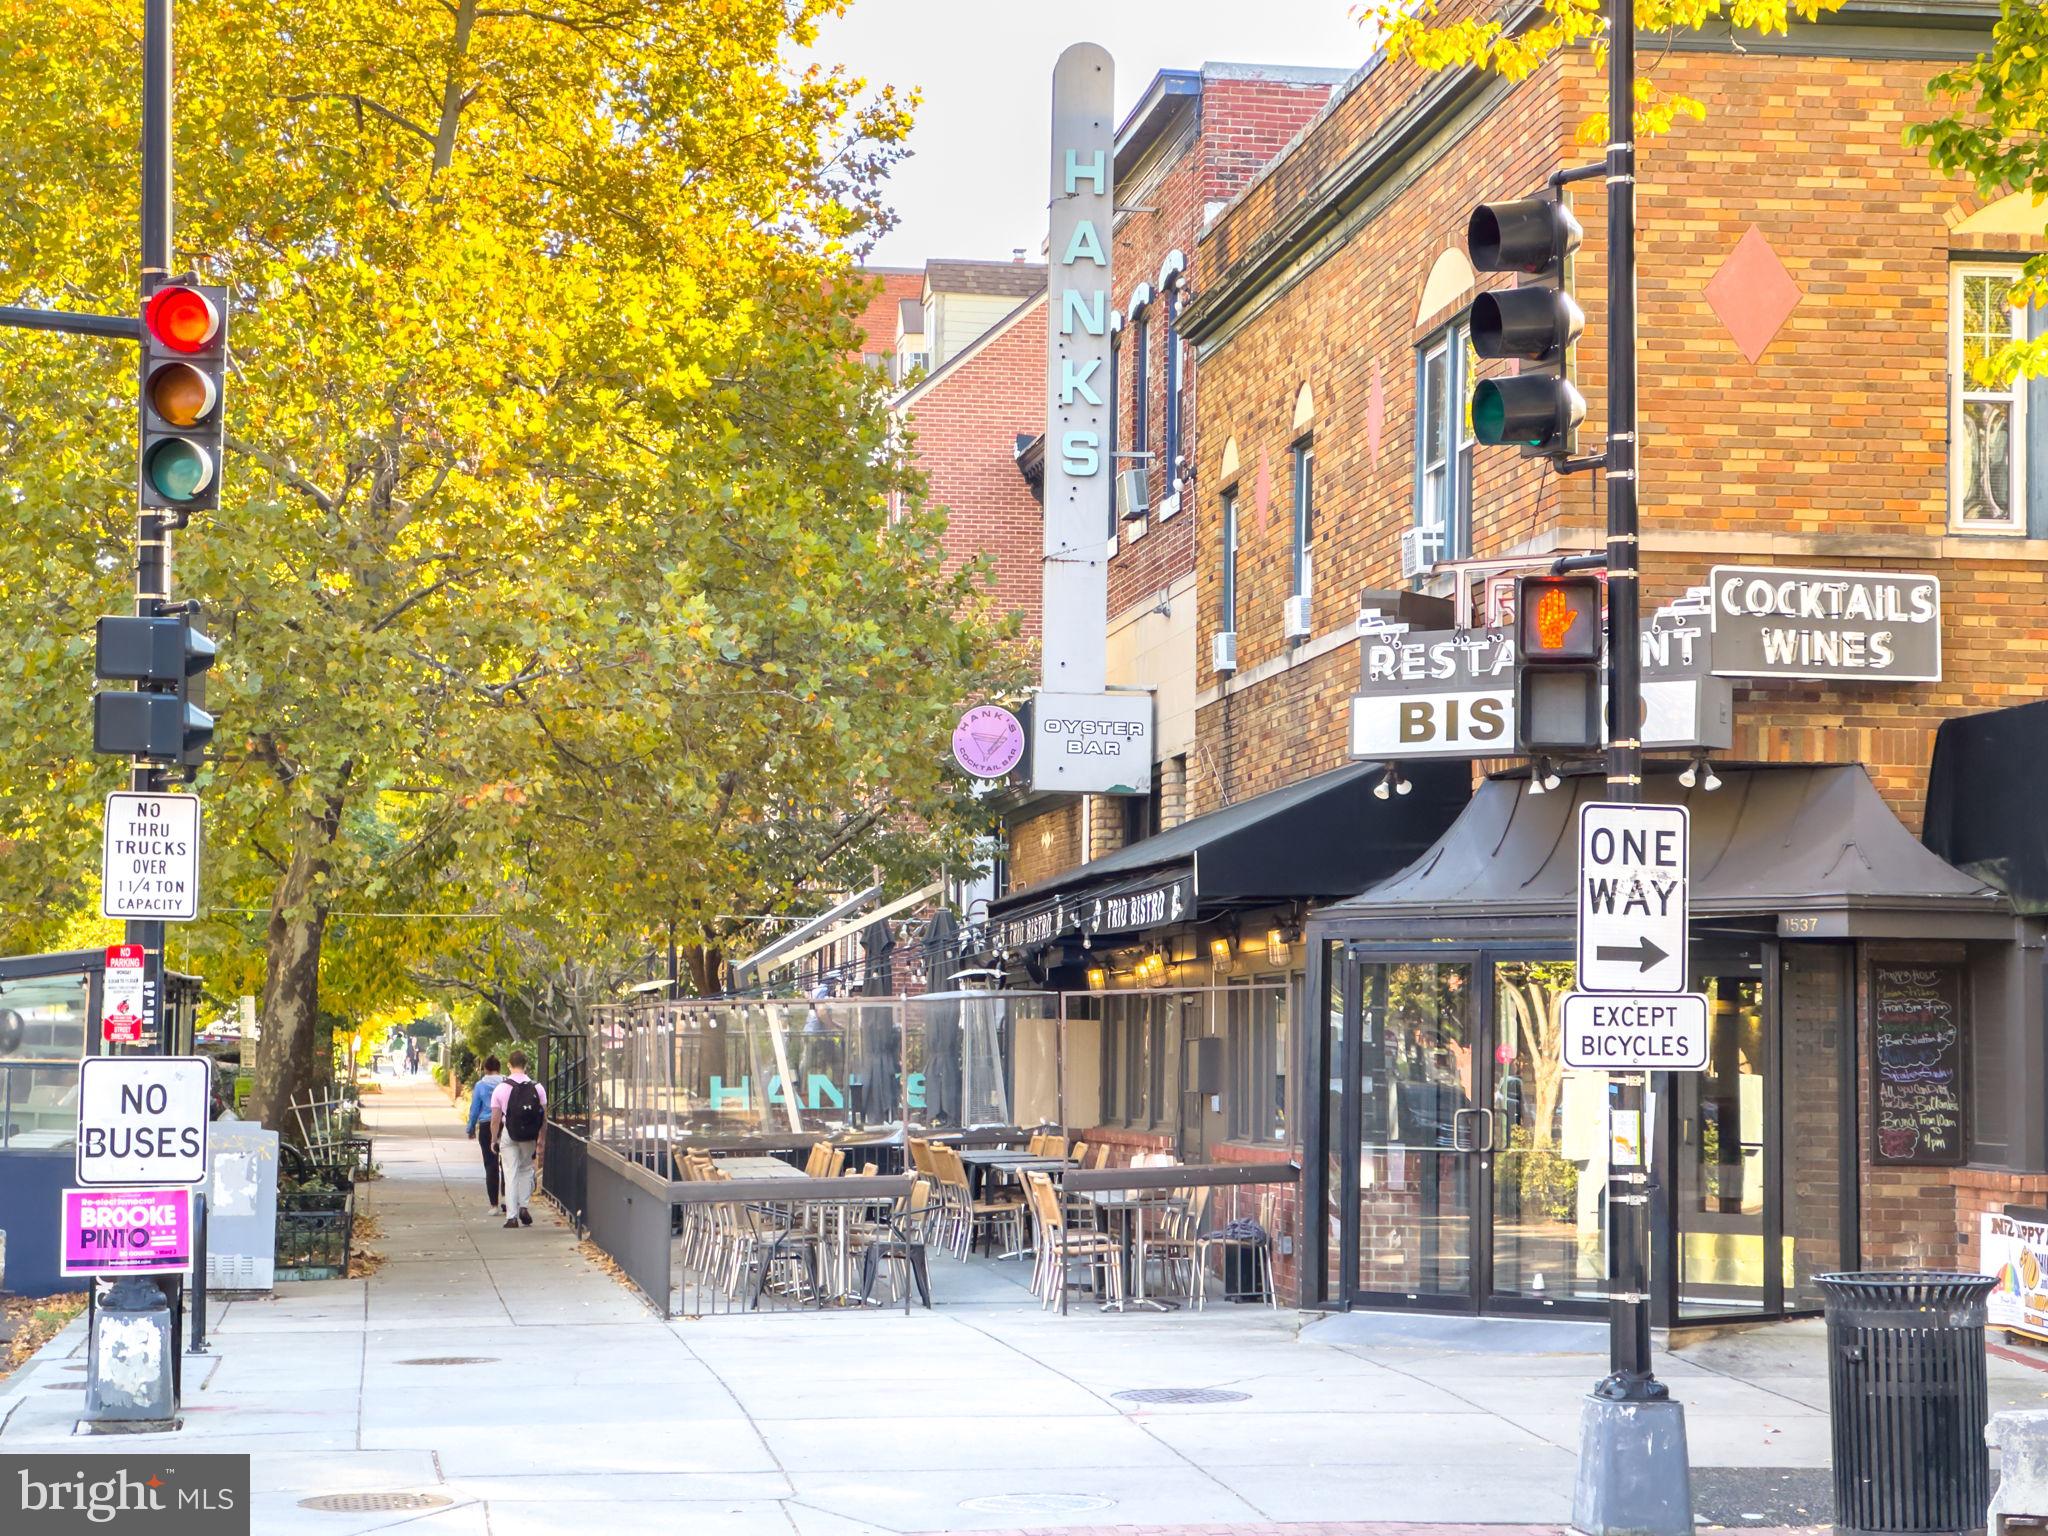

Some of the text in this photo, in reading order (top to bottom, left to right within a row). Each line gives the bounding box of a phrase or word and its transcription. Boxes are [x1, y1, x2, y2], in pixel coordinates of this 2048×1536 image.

[1062, 150, 1106, 476] HANKS
[1721, 577, 1937, 623] COCKTAILS
[1761, 627, 1895, 668] WINES
[1044, 719, 1144, 736] OYSTER
[1066, 740, 1121, 755] BAR
[960, 747, 1017, 772] COCKTAIL BAR
[137, 802, 161, 818] NO
[128, 822, 170, 838] THRU
[115, 840, 187, 856] TRUCKS
[1591, 827, 1677, 867] ONE
[133, 859, 167, 875] OVER
[156, 880, 185, 893] TON
[118, 899, 183, 911] CAPACITY
[1589, 877, 1678, 917] WAY
[1107, 890, 1166, 928] TRIO BISTRO
[1784, 917, 1819, 933] 1537
[120, 947, 131, 957] NO
[110, 958, 140, 968] PARKING
[1593, 1006, 1678, 1027] EXCEPT
[1582, 1035, 1689, 1057] BICYCLES
[121, 1083, 168, 1115] NO
[85, 1127, 201, 1159] BUSES
[81, 1204, 177, 1228] BROOKE
[81, 1228, 150, 1248] PINTO
